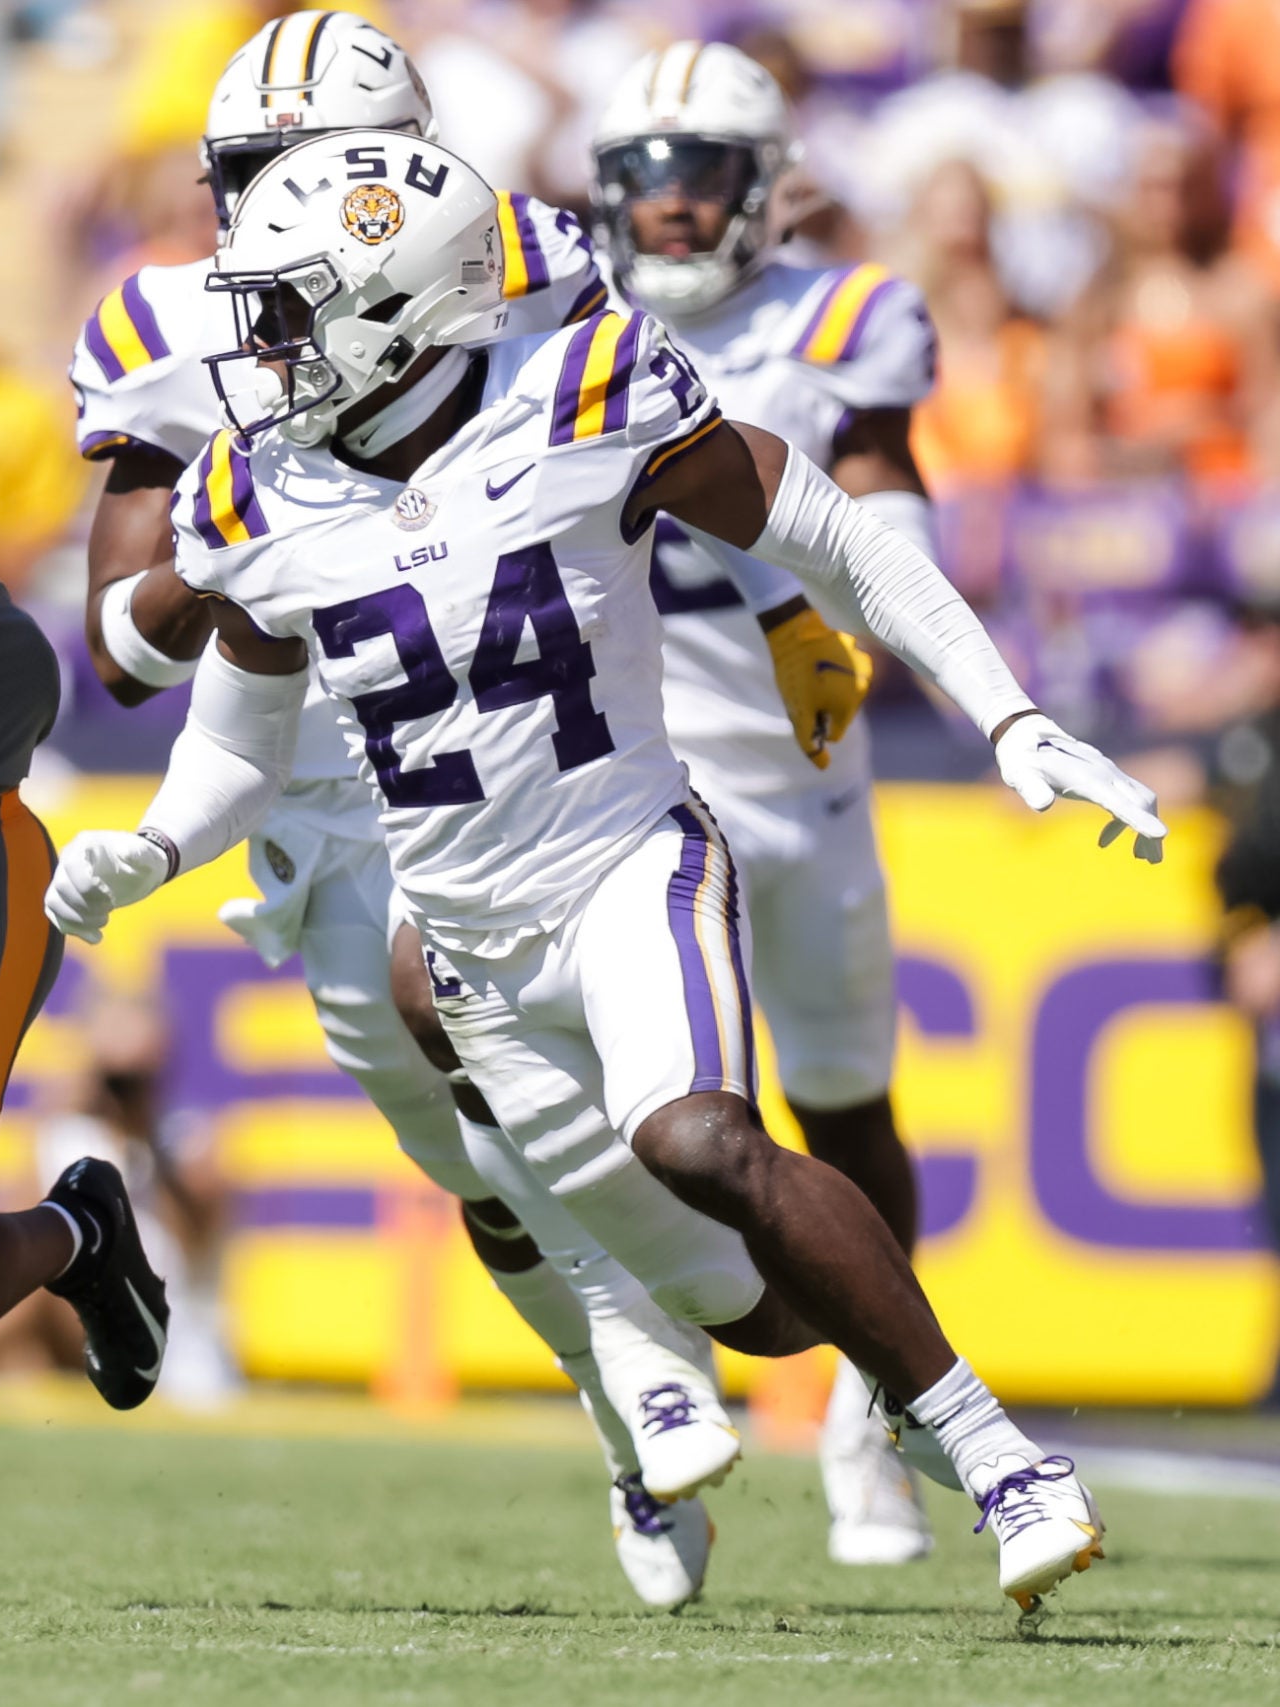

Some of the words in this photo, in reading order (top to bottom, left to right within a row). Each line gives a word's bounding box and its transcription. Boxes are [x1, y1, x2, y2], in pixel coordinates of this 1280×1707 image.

[282, 146, 450, 207] LSU
[393, 541, 449, 573] LSU
[312, 540, 616, 808] 24
